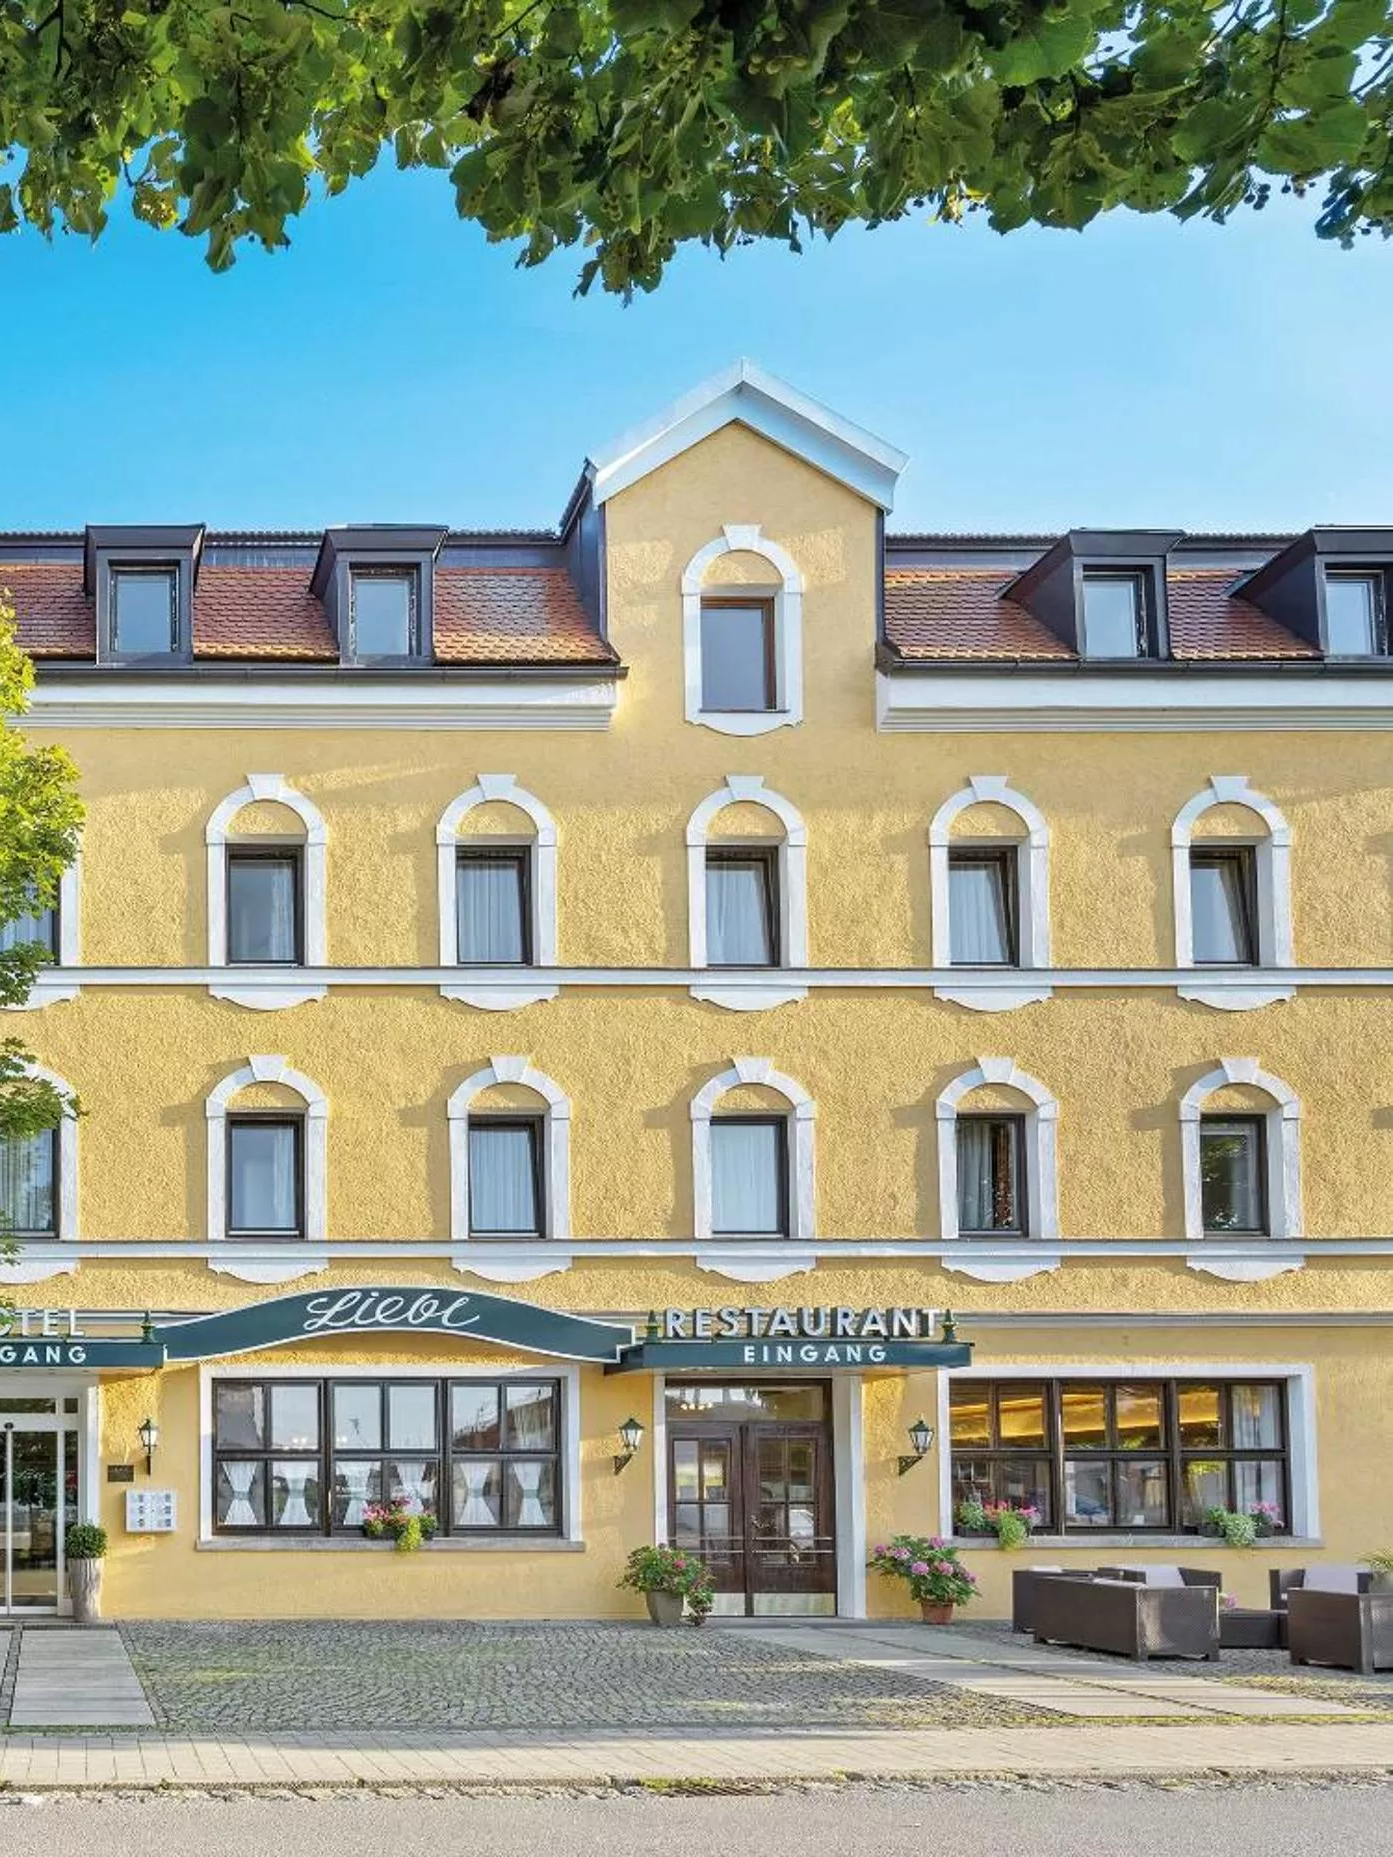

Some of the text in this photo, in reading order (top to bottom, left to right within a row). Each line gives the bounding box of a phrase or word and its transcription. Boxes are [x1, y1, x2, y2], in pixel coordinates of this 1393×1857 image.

[303, 1291, 480, 1330] Liebl
[665, 1307, 941, 1338] RESTAURANT
[743, 1345, 887, 1364] EINGANG
